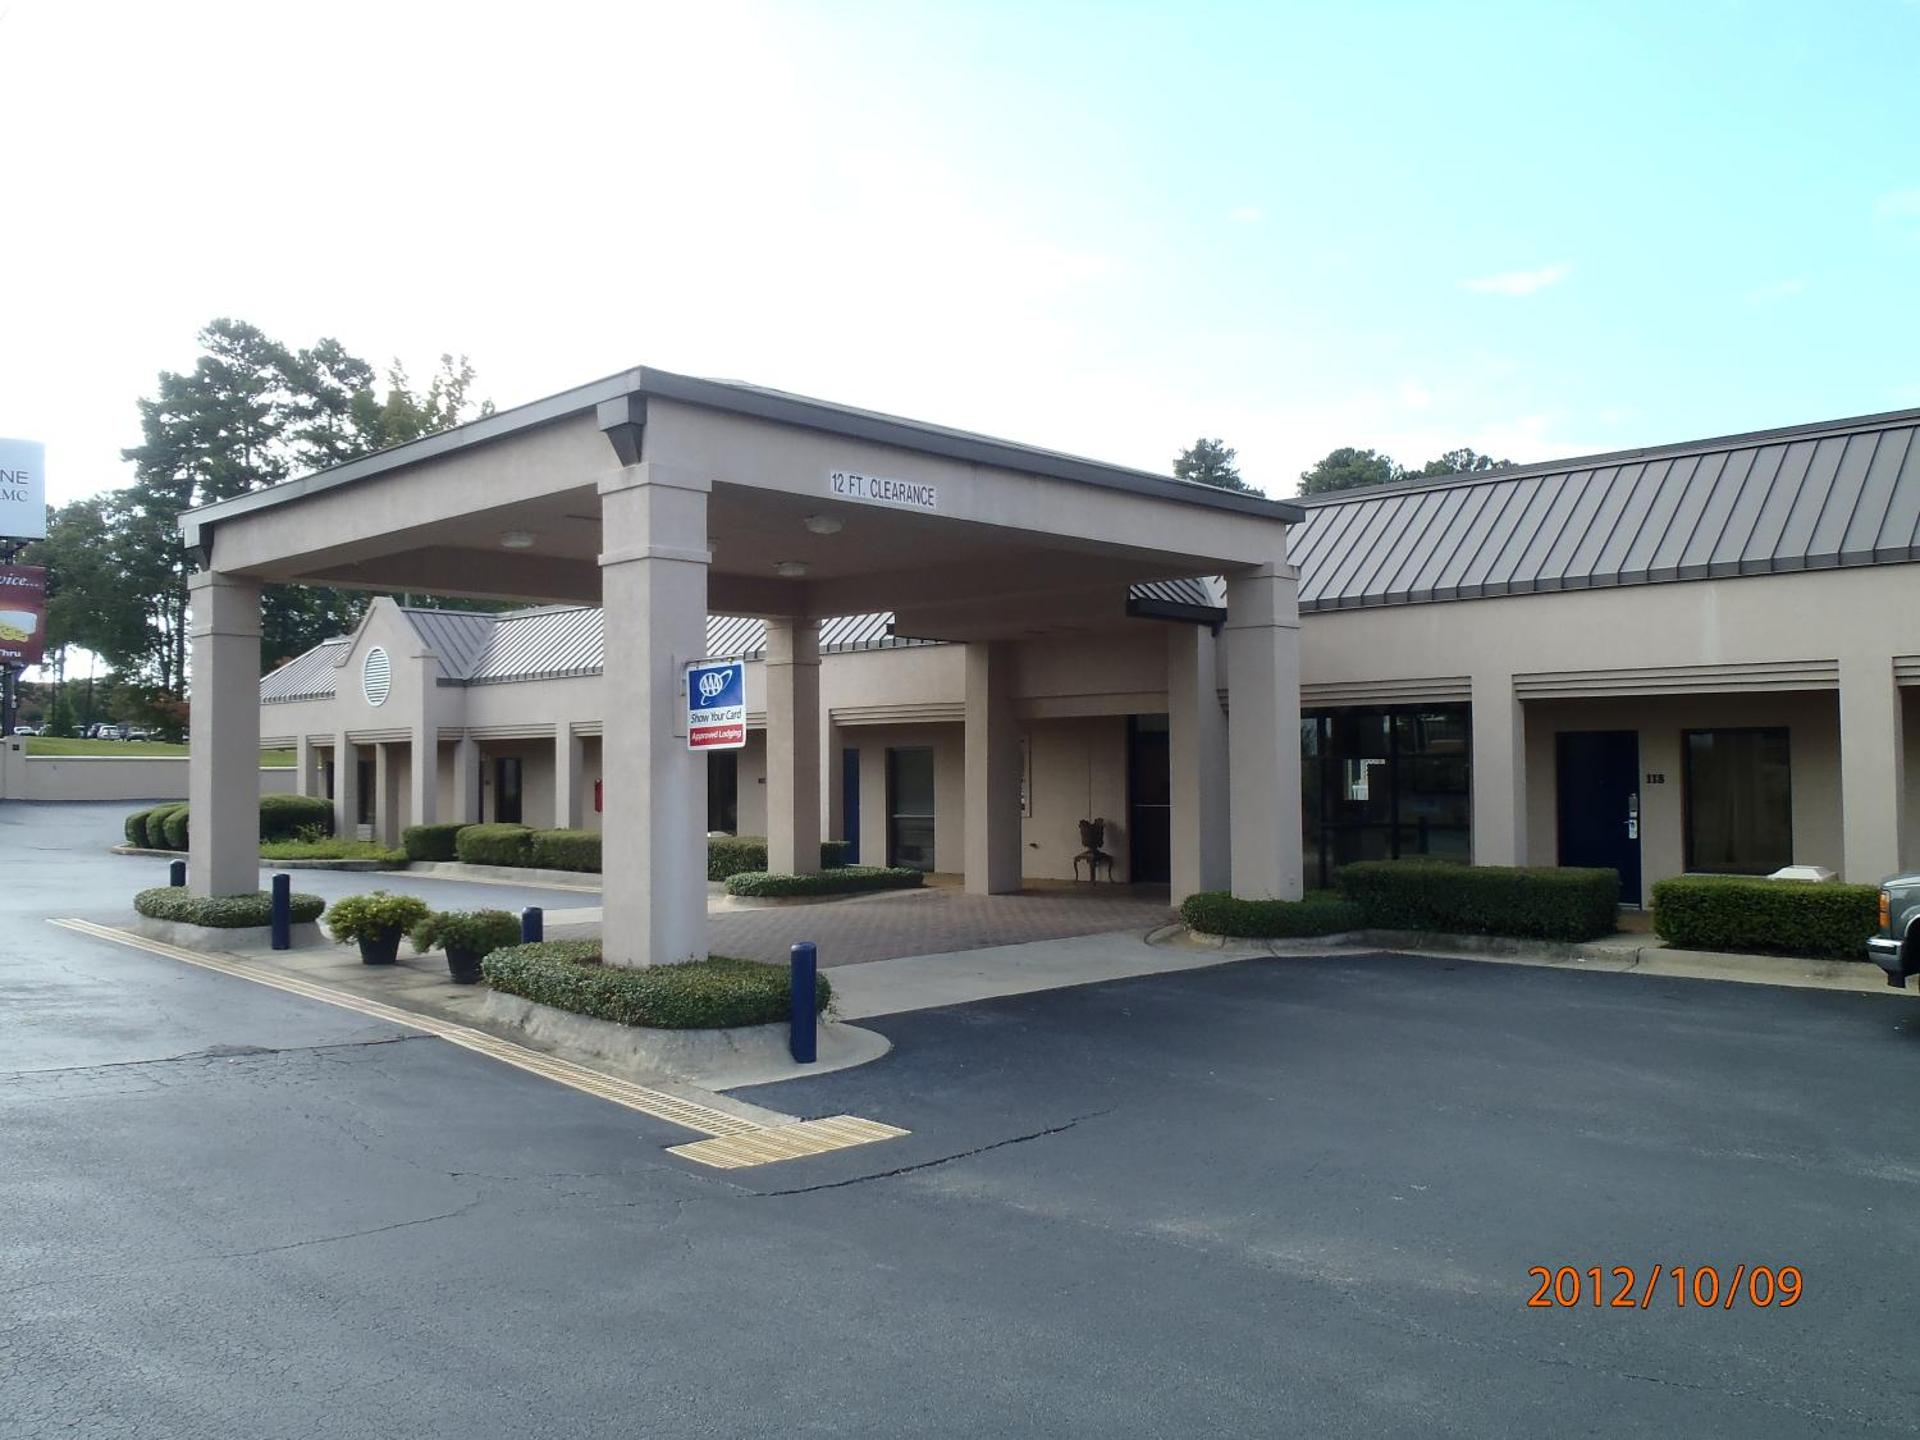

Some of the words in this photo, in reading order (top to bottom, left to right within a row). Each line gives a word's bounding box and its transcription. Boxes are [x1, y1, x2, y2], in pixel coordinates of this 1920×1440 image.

[0, 488, 29, 503] MC
[832, 473, 844, 493] 12
[849, 475, 866, 496] FT.
[870, 479, 934, 506] CLEARANCE
[690, 713, 710, 724] Show
[711, 712, 725, 722] Your
[726, 708, 742, 720] Card
[692, 731, 718, 743] Approved
[719, 729, 742, 740] Lodging
